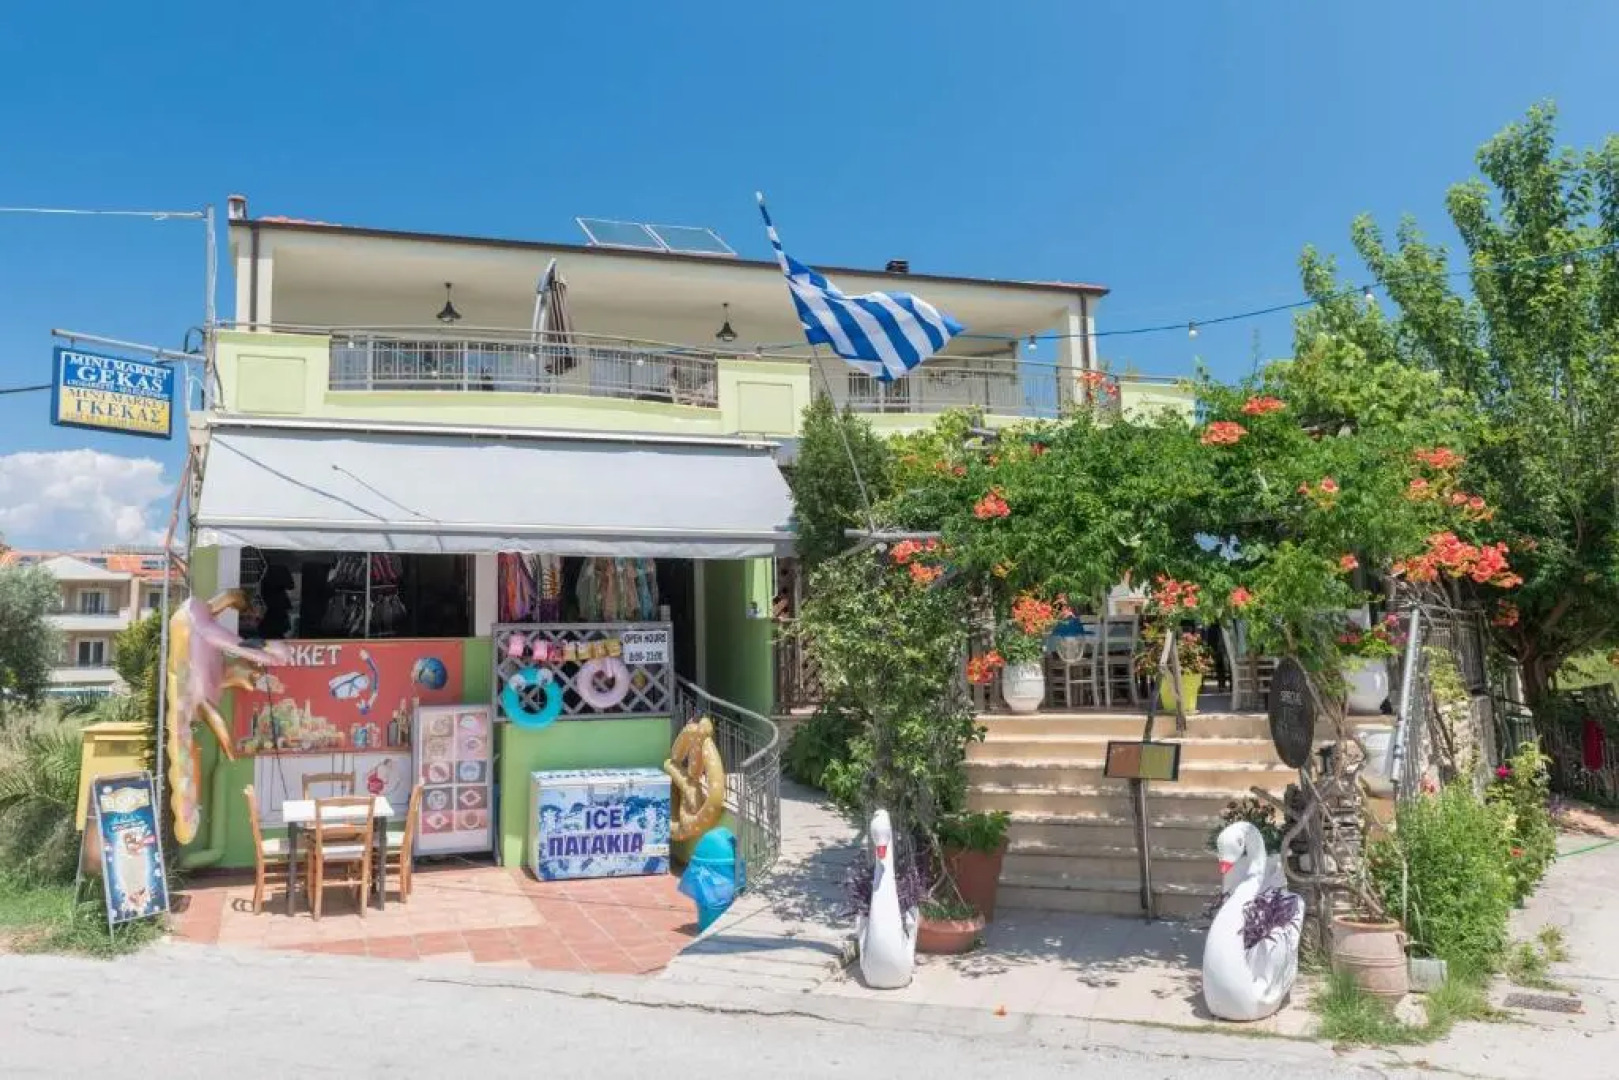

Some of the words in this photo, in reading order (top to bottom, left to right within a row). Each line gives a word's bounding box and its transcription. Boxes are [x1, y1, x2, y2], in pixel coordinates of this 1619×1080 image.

[70, 354, 106, 369] MINI
[113, 360, 170, 379] MARKET
[77, 366, 163, 394] GEKAS
[76, 399, 161, 423] ΓΚΕΚΑΣ
[625, 633, 643, 645] OPEN
[644, 633, 667, 643] HOURS
[585, 808, 623, 831] ICE
[548, 832, 644, 857] ΠΑΓΑΚΙΑ
